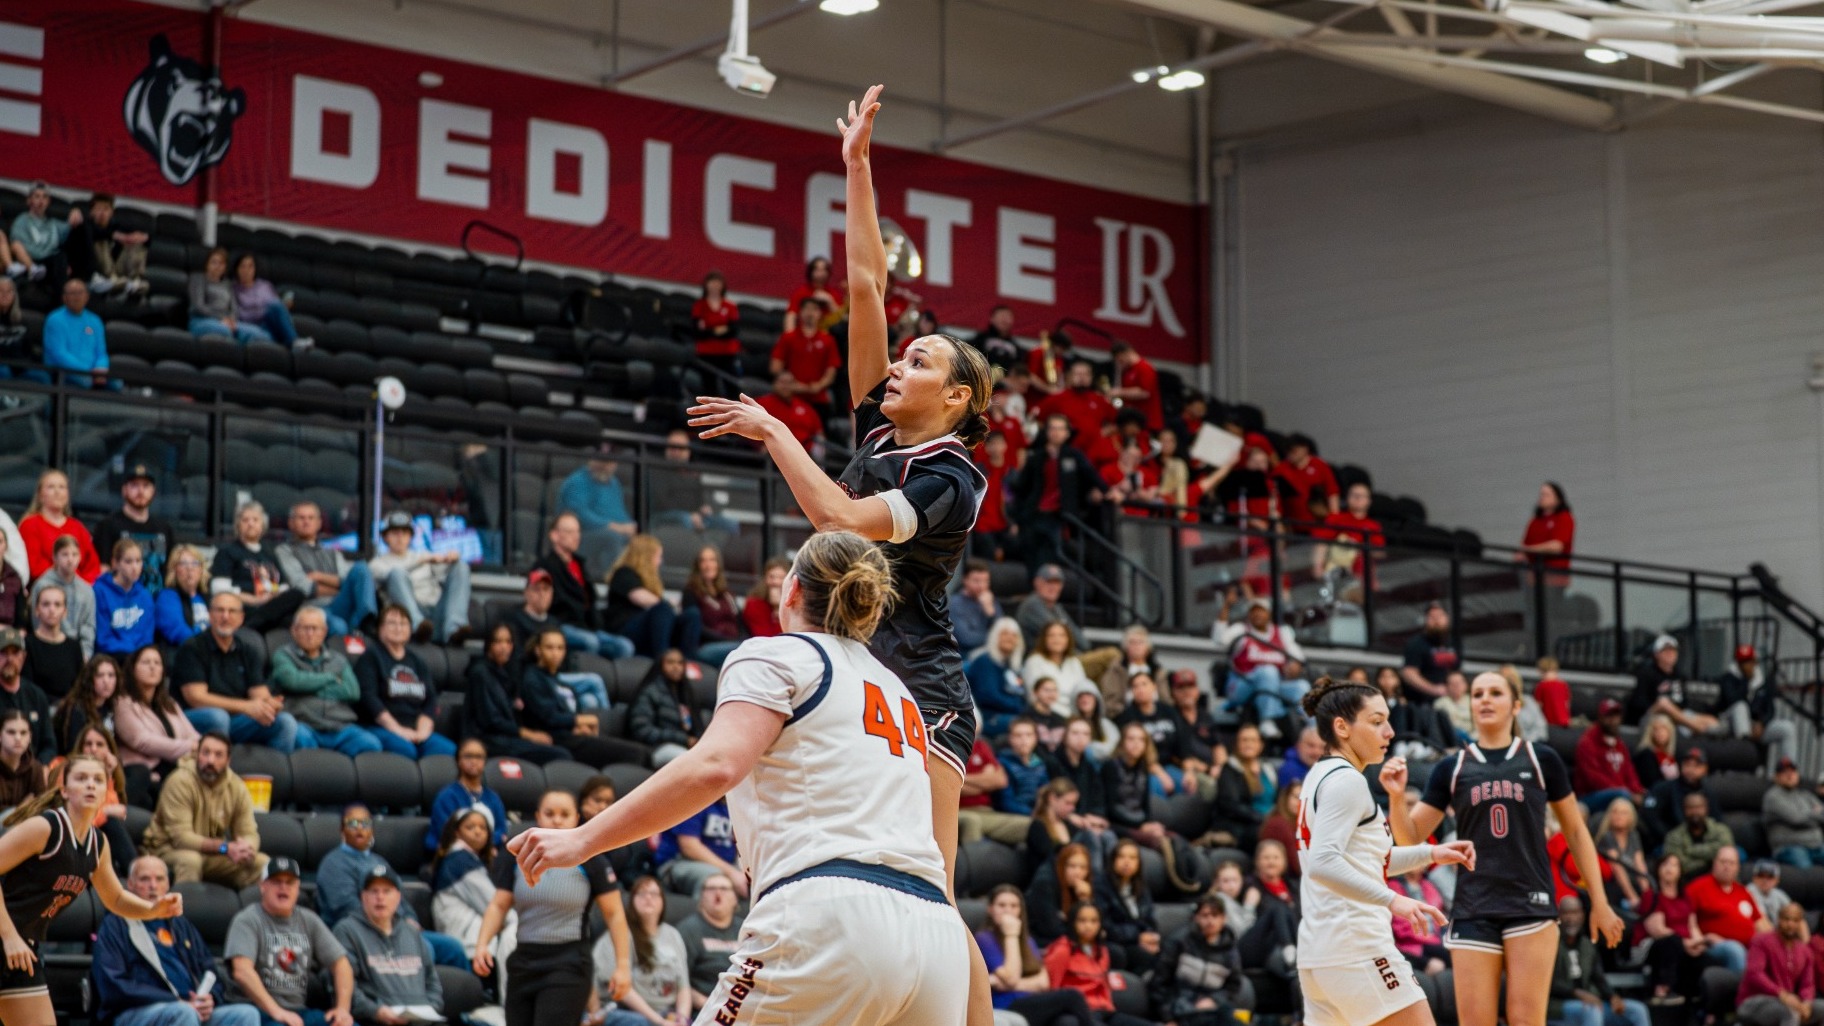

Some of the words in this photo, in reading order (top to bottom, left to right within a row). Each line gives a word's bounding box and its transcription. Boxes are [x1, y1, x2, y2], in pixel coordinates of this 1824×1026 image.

[290, 73, 1057, 305] DEDICATE
[1093, 216, 1187, 338] LR
[862, 680, 928, 773] 44
[1470, 779, 1525, 806] BEARS
[1489, 803, 1509, 839] 0
[1372, 956, 1400, 990] GLES
